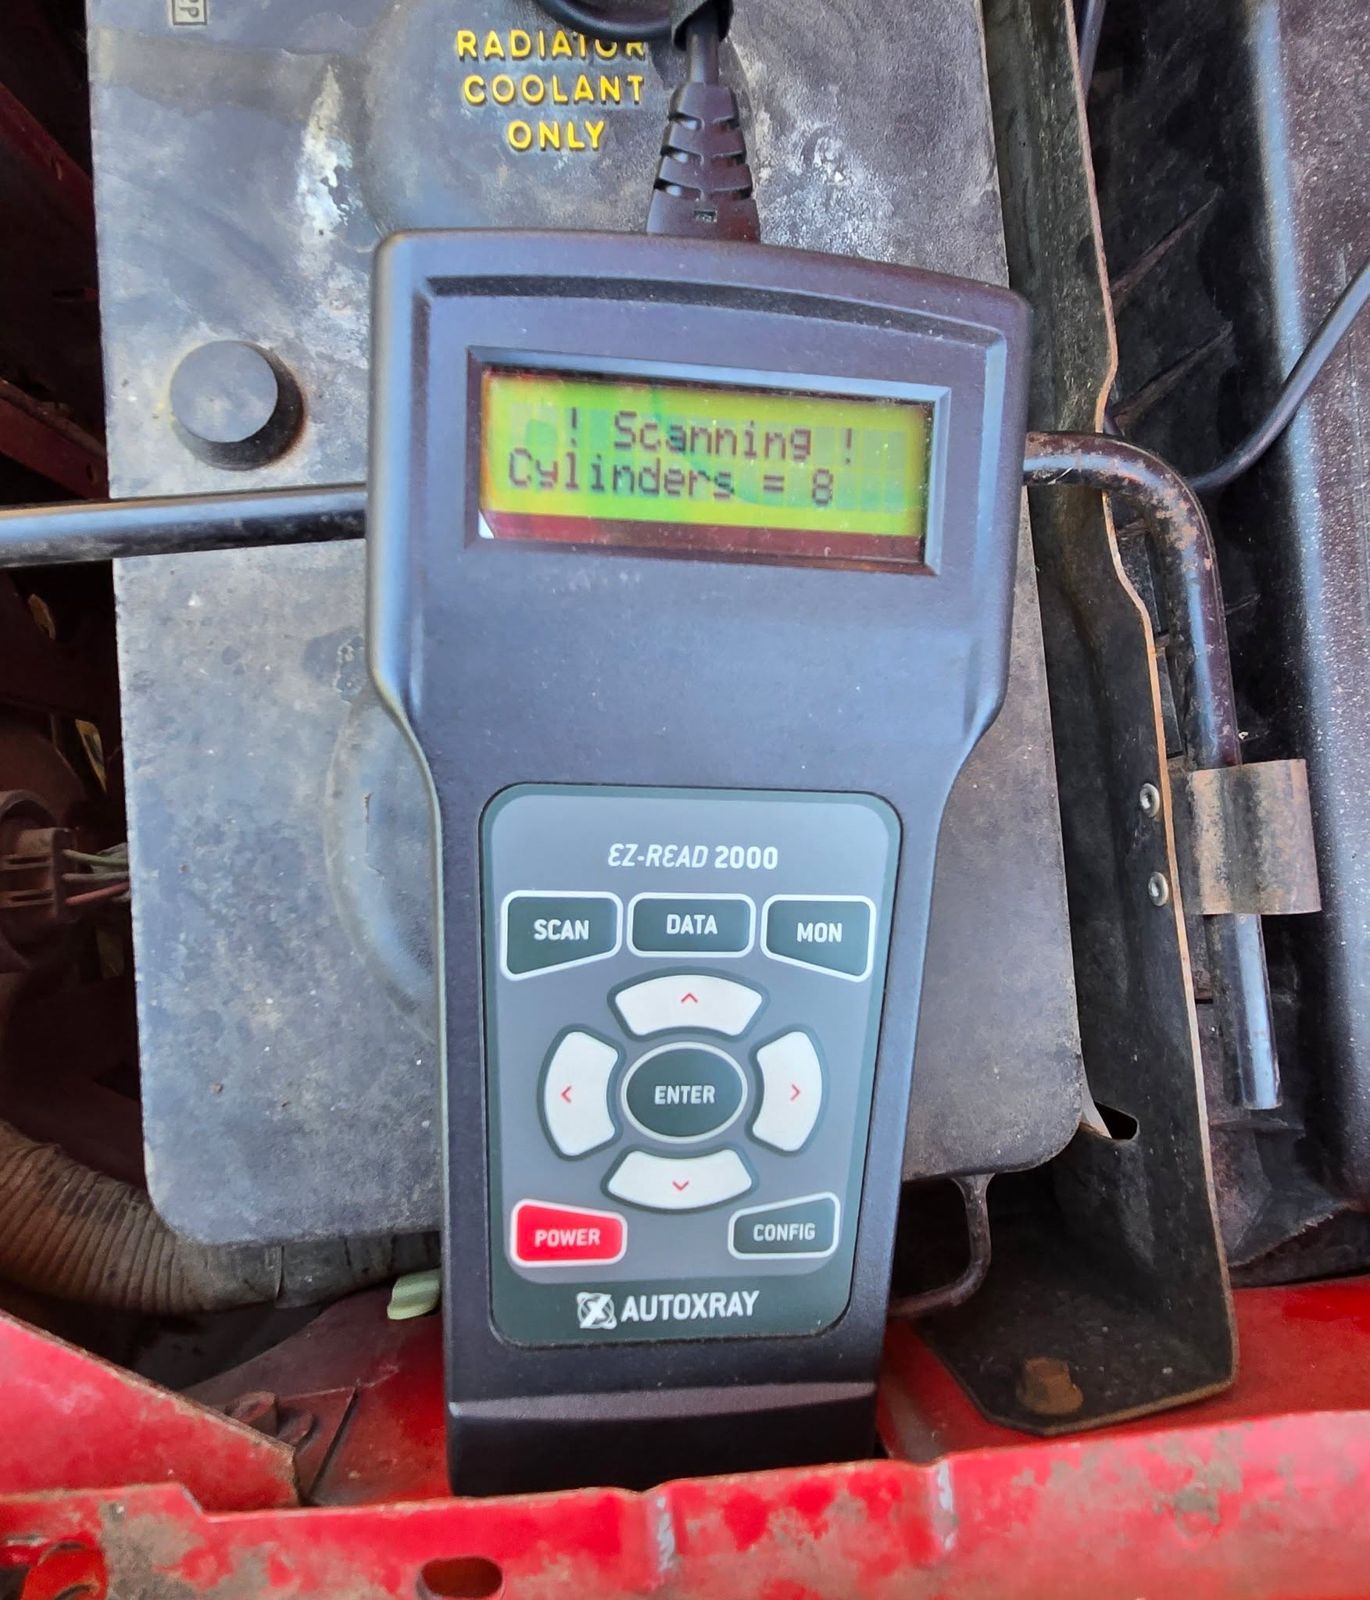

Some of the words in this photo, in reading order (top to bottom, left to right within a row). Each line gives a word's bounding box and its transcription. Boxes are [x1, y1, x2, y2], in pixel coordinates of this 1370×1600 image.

[463, 73, 645, 104] COOLANT
[507, 119, 606, 150] ONLY
[614, 410, 813, 461] Scanning
[508, 447, 735, 500] Cylinders
[763, 474, 785, 494] =
[812, 468, 834, 506] 8
[607, 843, 709, 869] EZ-READ
[714, 845, 779, 871] 2000
[533, 919, 590, 941] SCAN
[665, 914, 718, 936] DATA
[796, 922, 843, 944] MON
[654, 1084, 716, 1106] ENTER
[534, 1228, 602, 1249] POWER
[752, 1223, 816, 1243] CONFIG
[620, 1290, 761, 1323] AUTOXRAY
